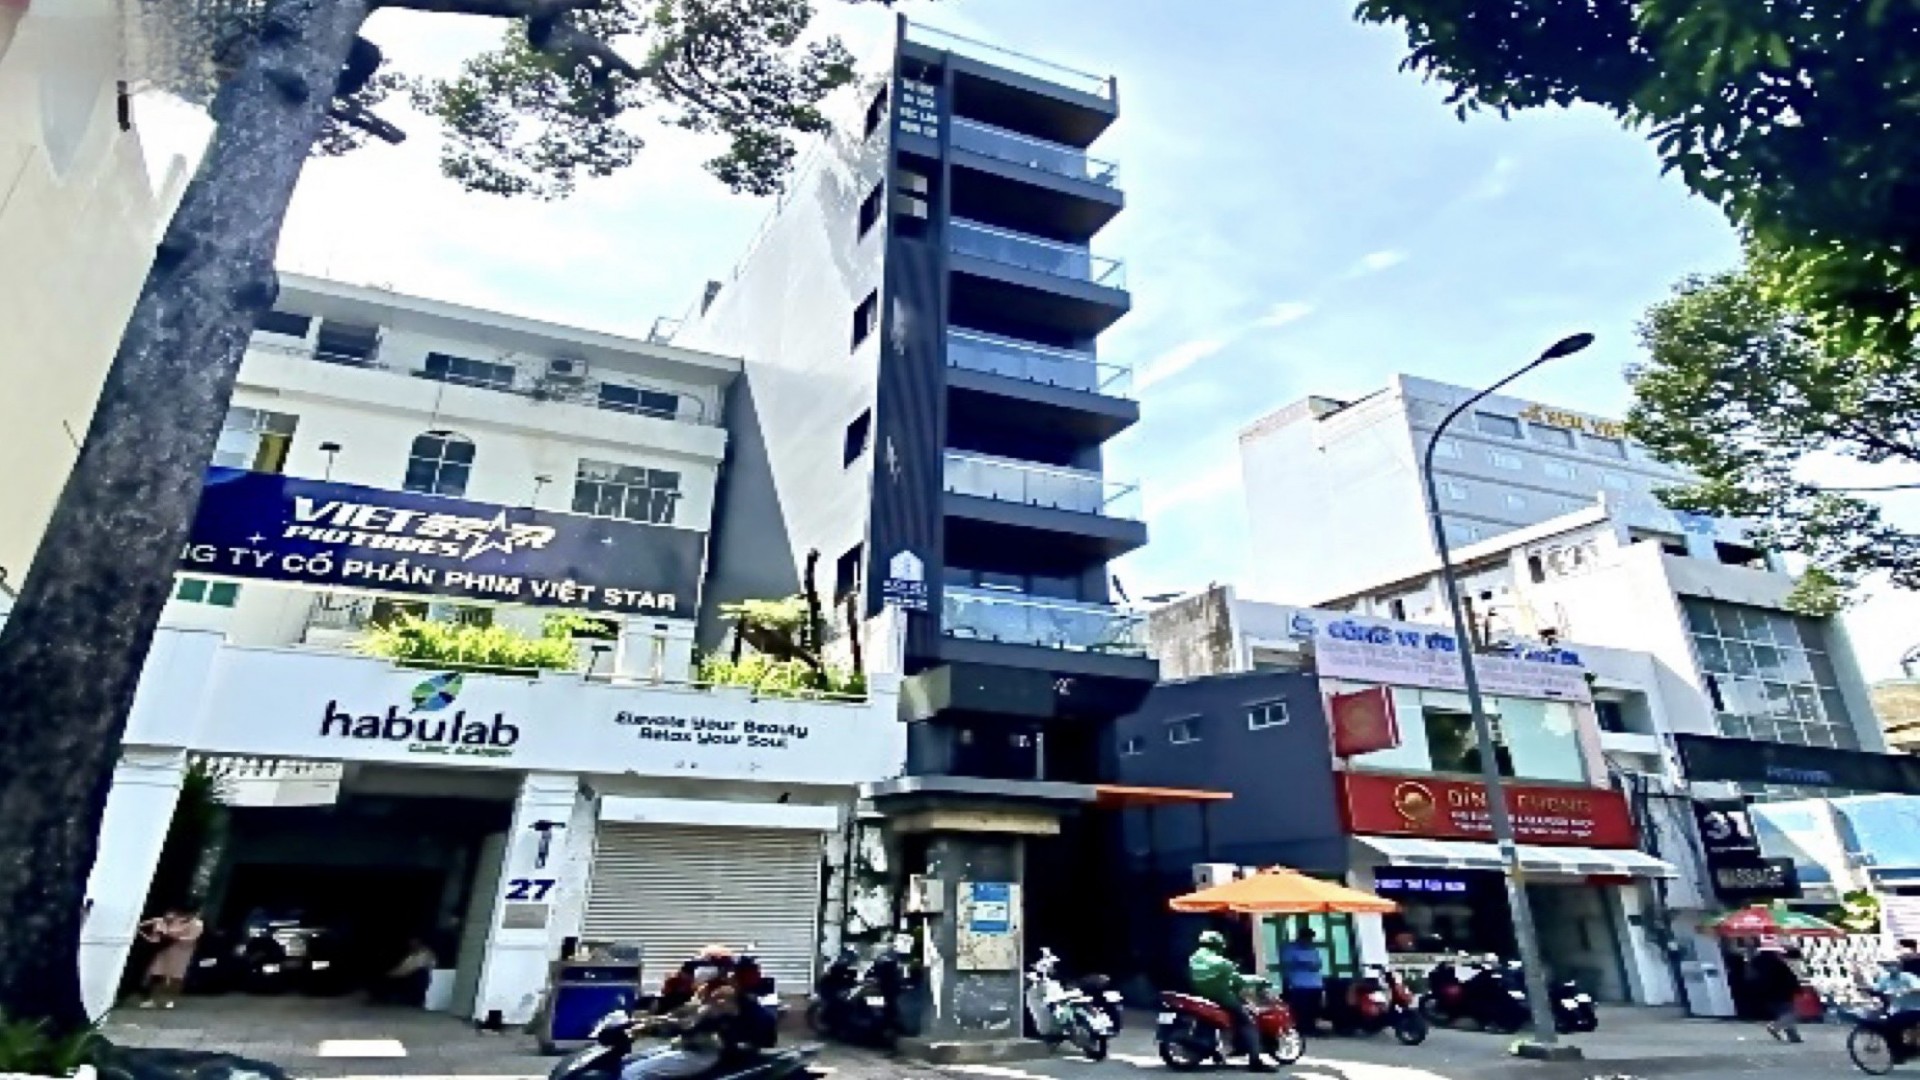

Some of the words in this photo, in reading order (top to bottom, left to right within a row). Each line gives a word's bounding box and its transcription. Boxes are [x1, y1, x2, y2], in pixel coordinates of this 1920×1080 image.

[229, 547, 273, 567] TY
[445, 571, 522, 595] PHIM
[604, 588, 677, 612] STAR
[320, 699, 519, 747] habulab
[743, 719, 809, 739] Beauty
[1703, 811, 1752, 839] 31
[505, 878, 556, 901] 27
